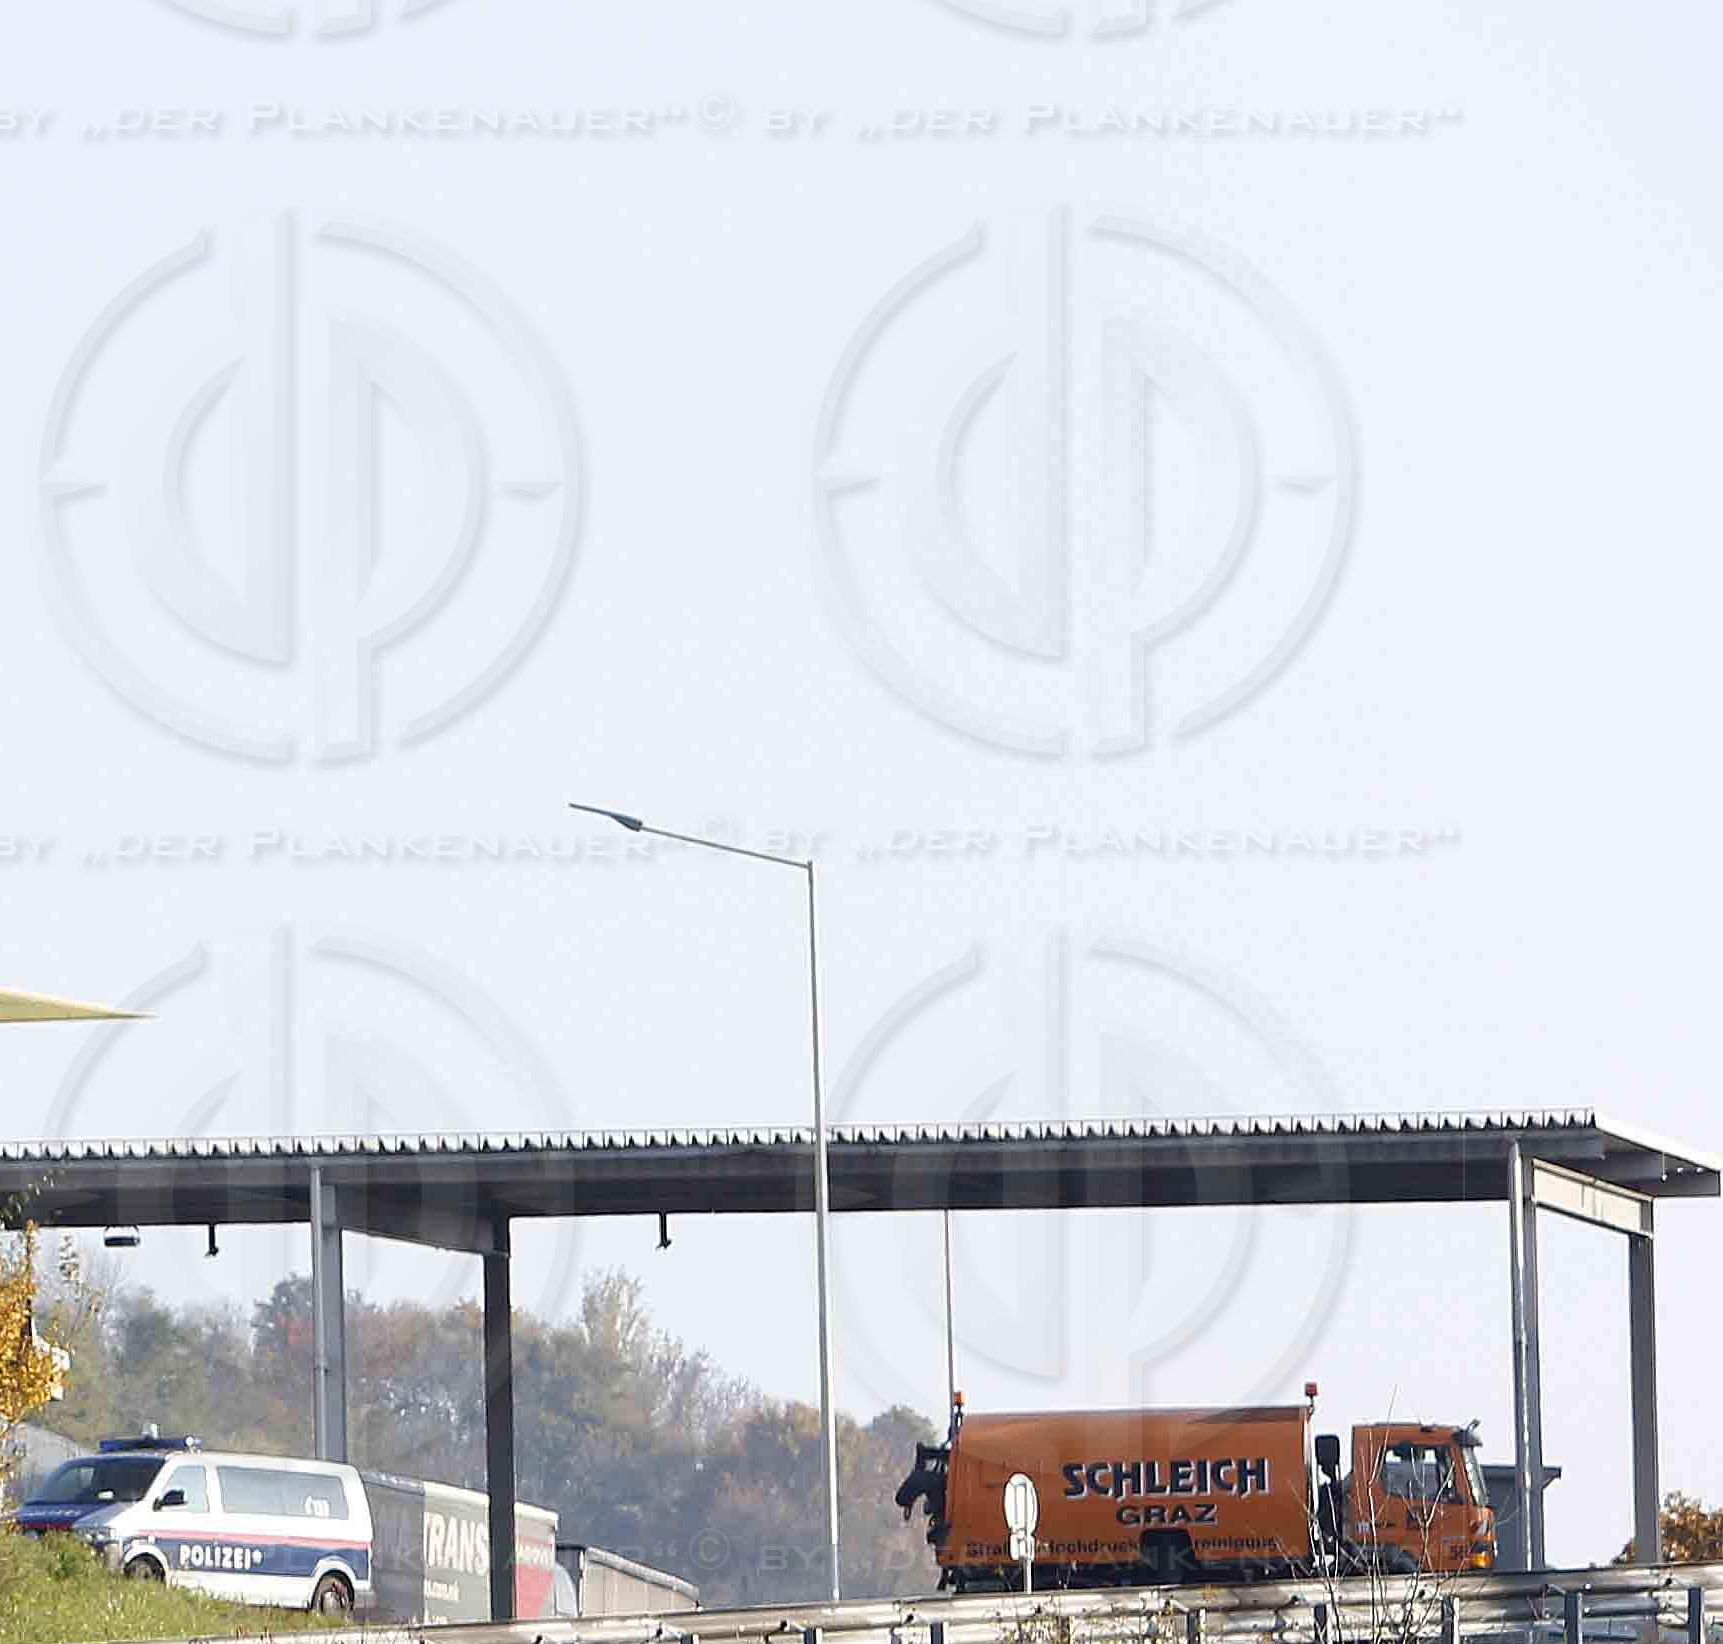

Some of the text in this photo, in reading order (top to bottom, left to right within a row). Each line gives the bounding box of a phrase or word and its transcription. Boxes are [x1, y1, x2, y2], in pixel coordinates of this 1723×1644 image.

[1062, 1457, 1270, 1502] SCHLEICH
[1115, 1503, 1219, 1528] GRAZ
[178, 1543, 252, 1570] POLIZEI
